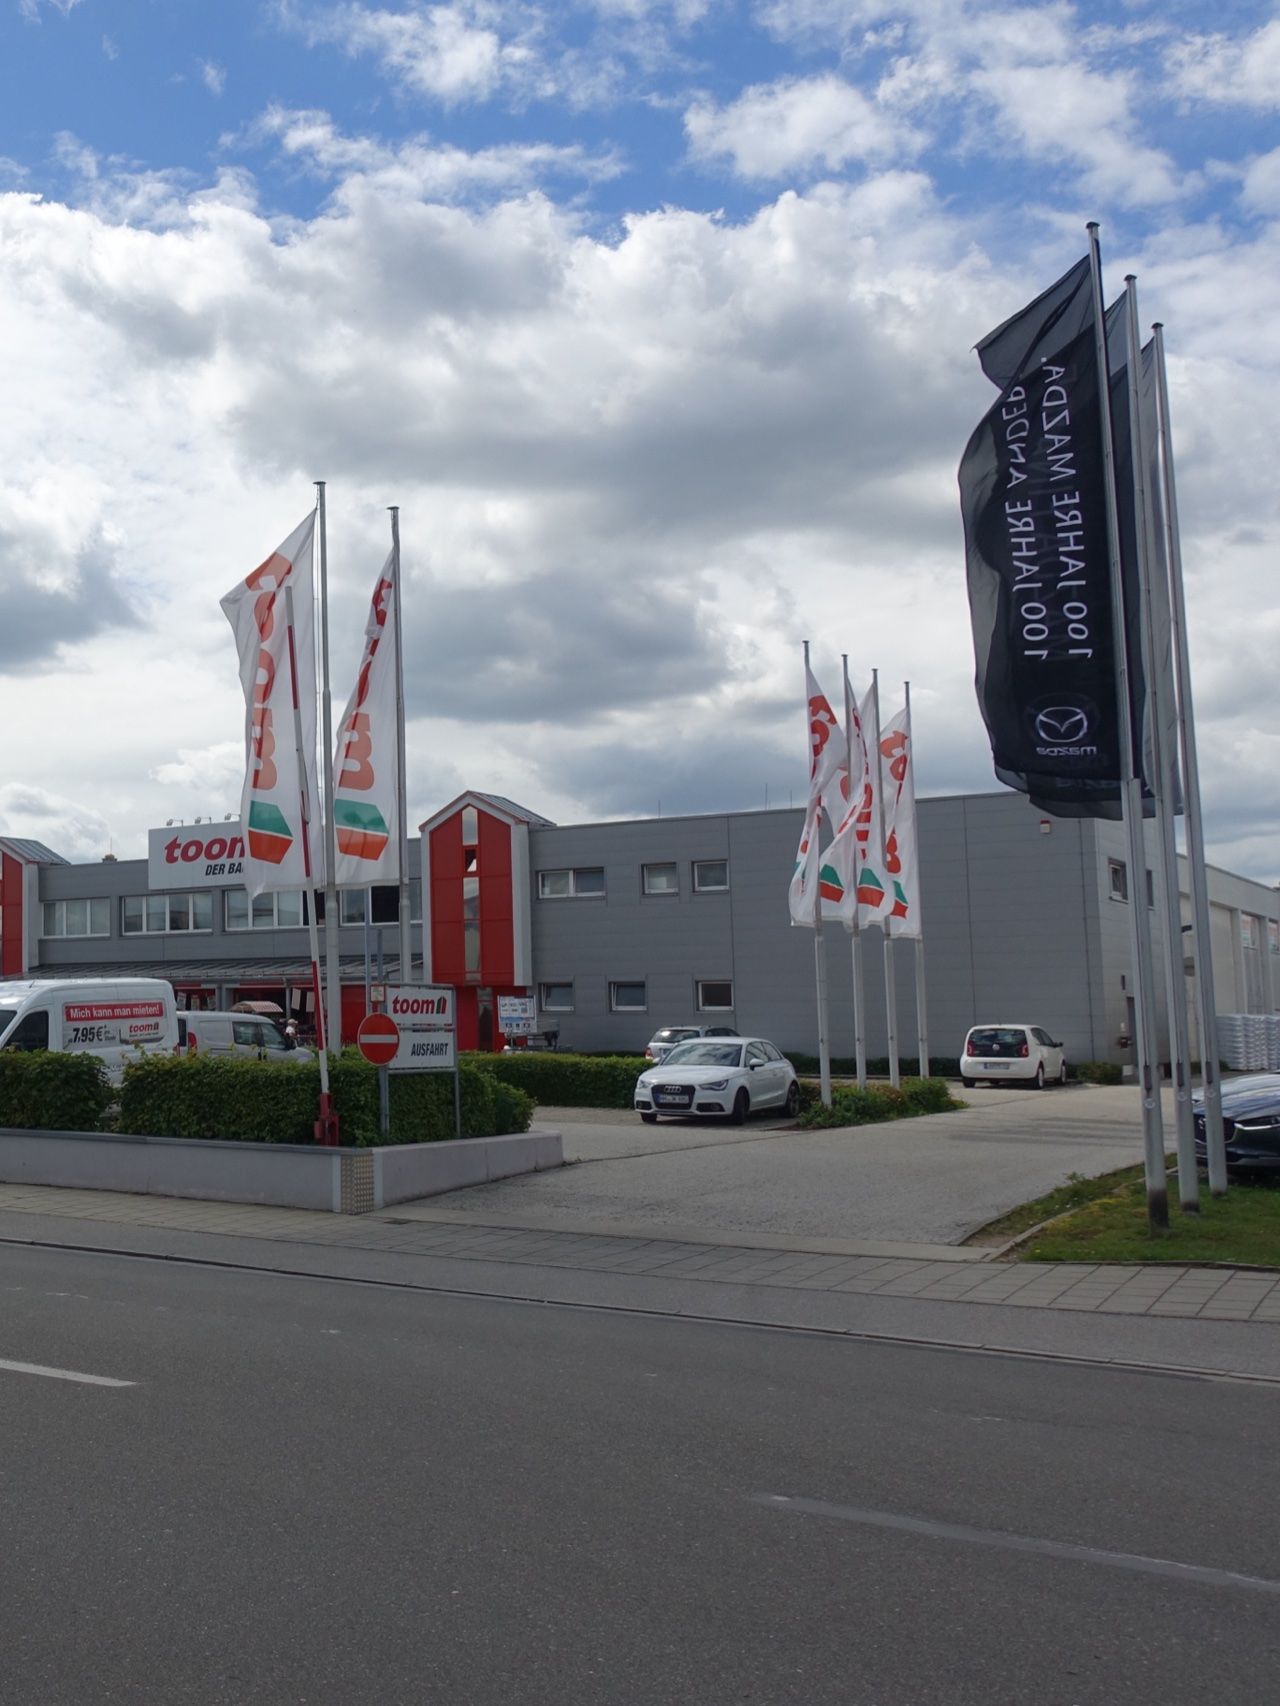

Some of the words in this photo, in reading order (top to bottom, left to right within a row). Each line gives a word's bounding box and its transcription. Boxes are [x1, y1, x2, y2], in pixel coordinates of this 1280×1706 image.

[205, 863, 226, 876] DER
[70, 1007, 91, 1018] Mich
[93, 1006, 112, 1017] kann
[114, 1005, 131, 1015] man
[132, 1004, 159, 1014] mieten!
[392, 995, 435, 1014] toom
[129, 1023, 152, 1033] toom
[410, 1043, 449, 1056] AUSFAHRT
